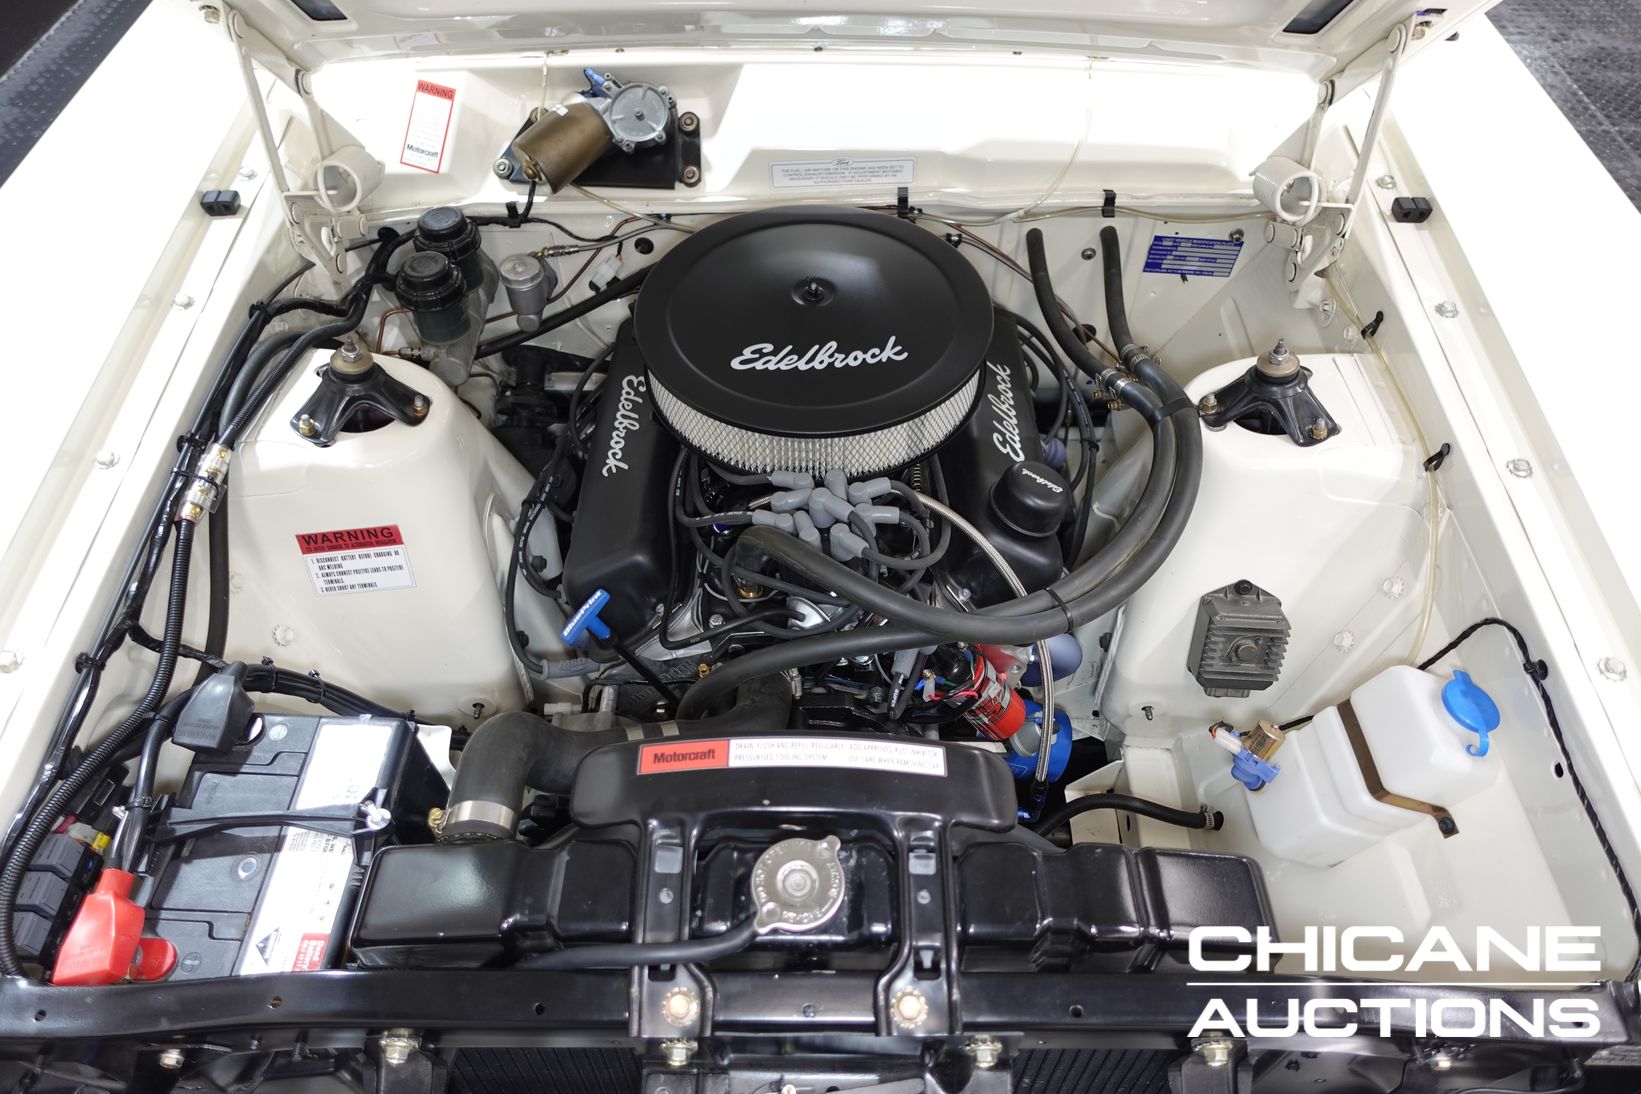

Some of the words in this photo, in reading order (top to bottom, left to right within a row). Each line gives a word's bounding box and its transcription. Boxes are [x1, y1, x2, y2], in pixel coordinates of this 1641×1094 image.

[417, 81, 454, 99] WARNING
[406, 144, 439, 158] Motorcraft
[730, 336, 908, 371] Edelbrock
[986, 361, 1025, 462] Edelbrock
[602, 375, 646, 476] Edelbrock
[1022, 468, 1063, 493] Edelbrock
[302, 528, 393, 545] WARNING
[653, 749, 715, 764] Motorcraft
